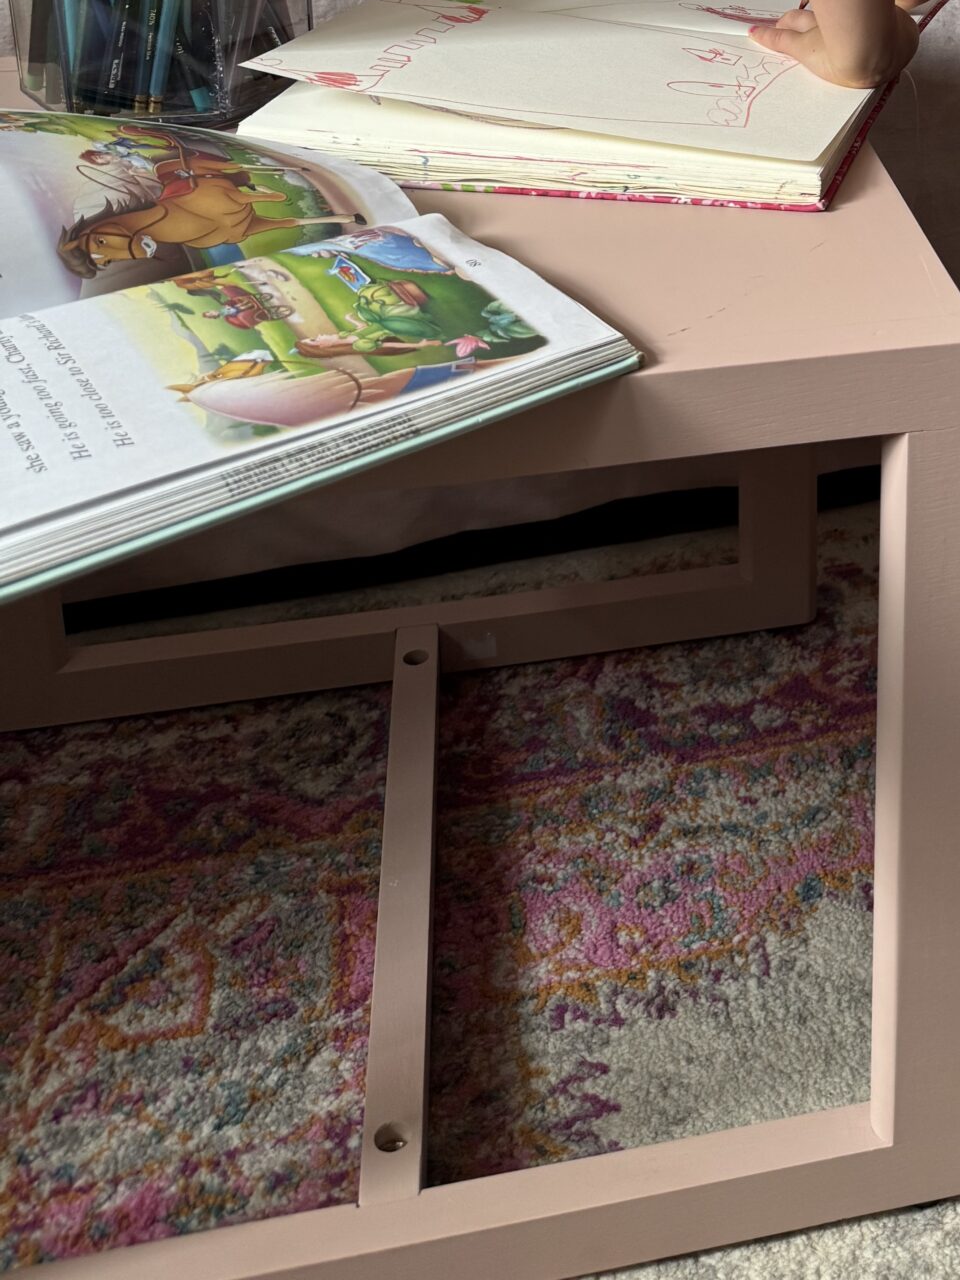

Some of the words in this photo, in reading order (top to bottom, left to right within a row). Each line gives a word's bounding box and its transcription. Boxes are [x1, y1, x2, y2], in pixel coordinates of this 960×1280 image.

[55, 352, 76, 365] Sir
[68, 366, 84, 375] to
[33, 385, 53, 400] too
[76, 378, 102, 400] close
[0, 389, 21, 421] you
[94, 403, 115, 418] too
[44, 401, 78, 429] going
[7, 421, 21, 429] a
[104, 420, 123, 430] is
[12, 431, 35, 452] saw
[61, 431, 80, 442] is
[112, 431, 135, 448] He
[70, 442, 92, 460] He
[26, 453, 48, 473] she
